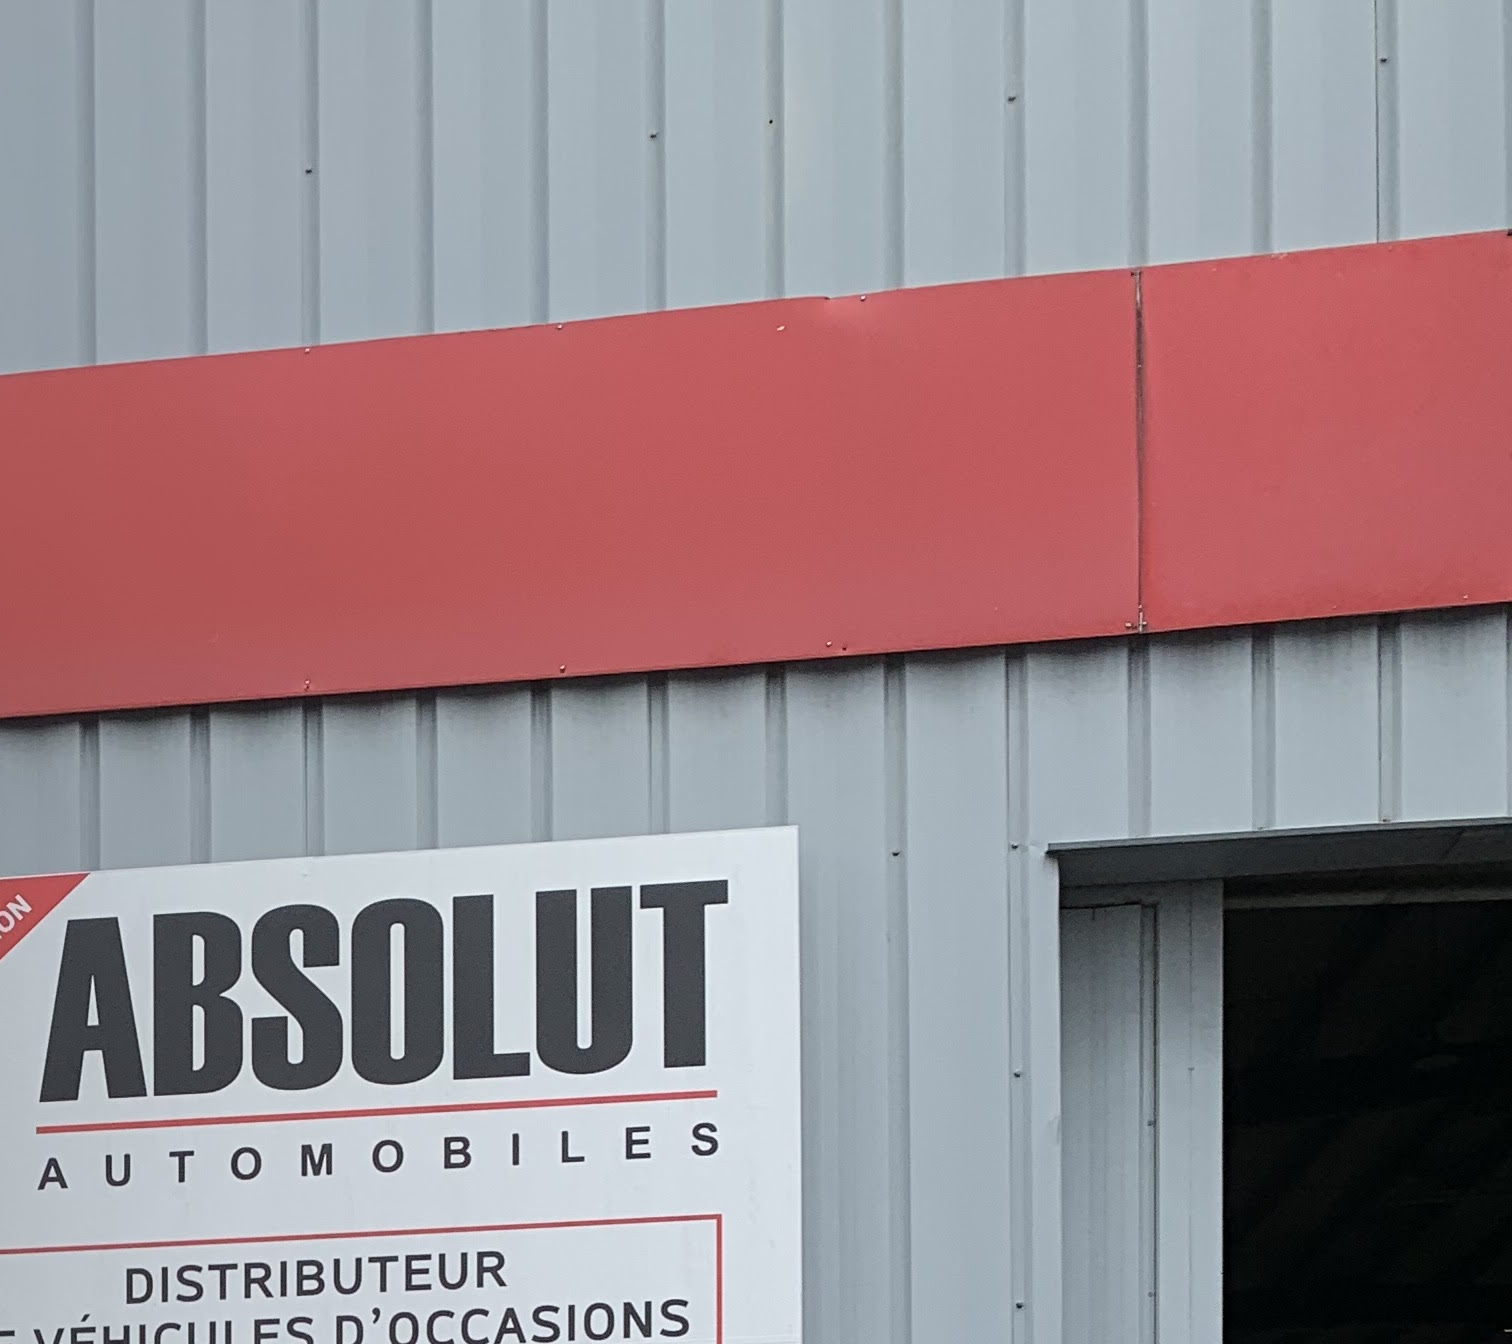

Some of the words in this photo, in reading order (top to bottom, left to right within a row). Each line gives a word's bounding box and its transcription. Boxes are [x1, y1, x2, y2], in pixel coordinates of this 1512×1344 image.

[39, 880, 728, 1103] ABSOLUT
[36, 1123, 719, 1191] AUTOMOBILES
[126, 1251, 507, 1306] DISTRIBUTEUR
